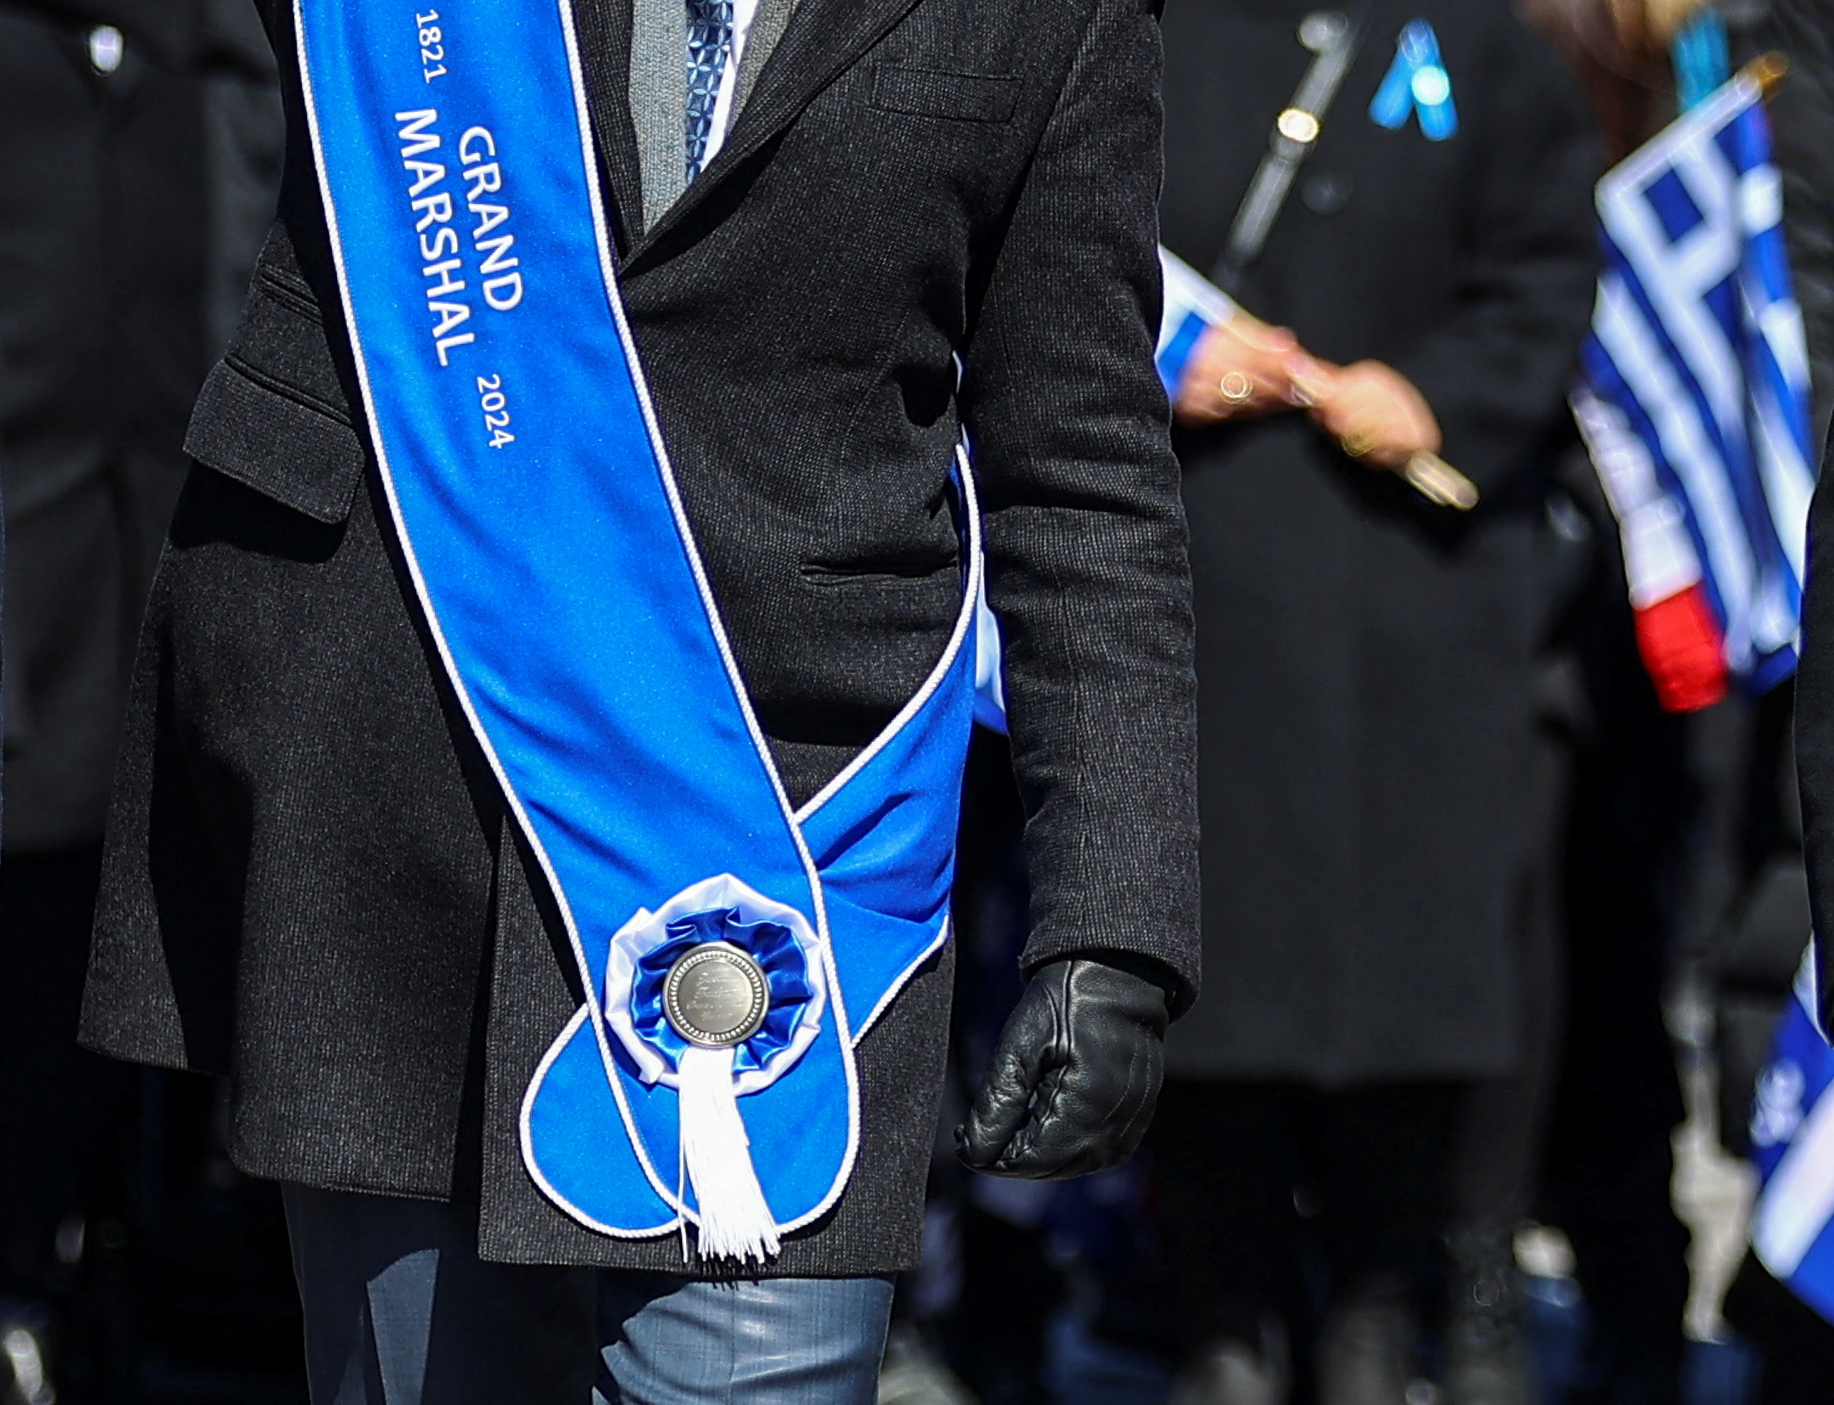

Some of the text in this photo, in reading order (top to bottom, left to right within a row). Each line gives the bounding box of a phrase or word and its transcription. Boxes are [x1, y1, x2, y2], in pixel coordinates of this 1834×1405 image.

[414, 8, 447, 85] 1821
[393, 107, 476, 368] MARSHAL
[457, 124, 524, 312] GRAND
[475, 372, 516, 450] 2024
